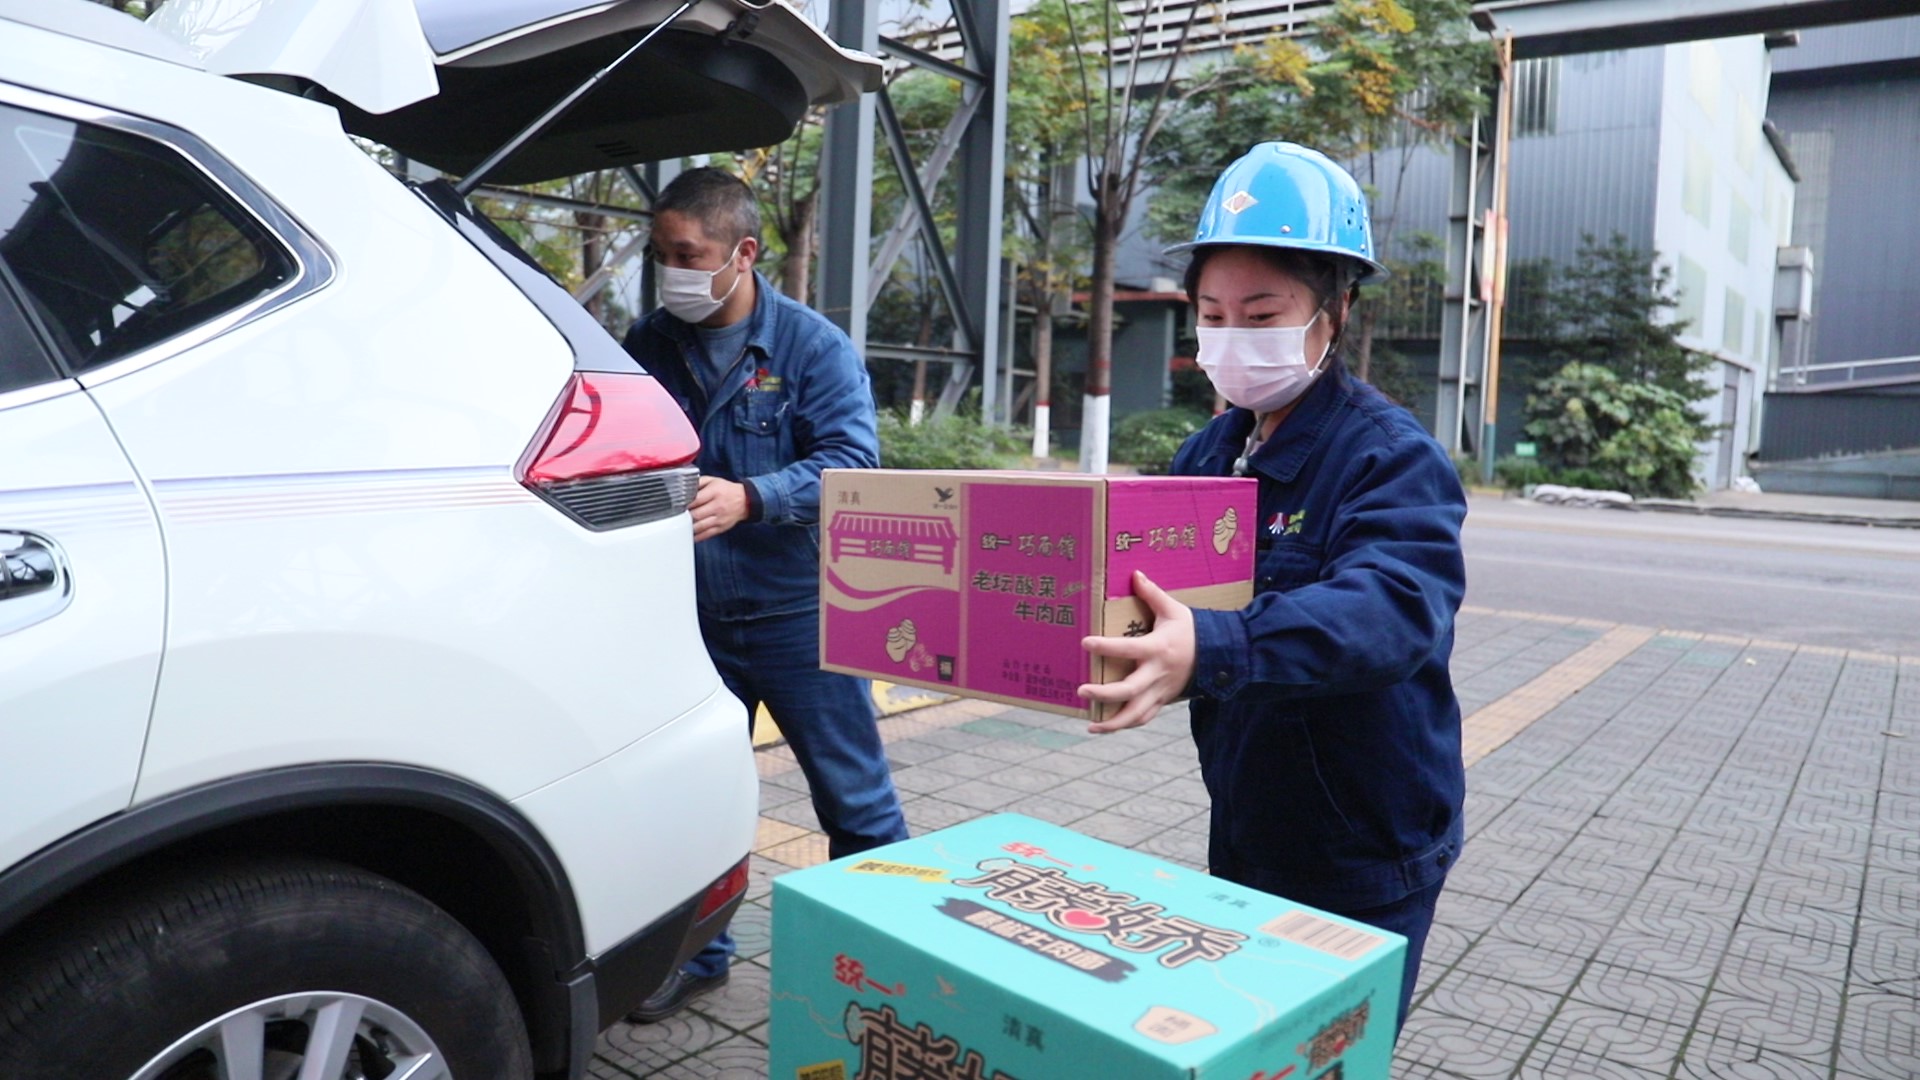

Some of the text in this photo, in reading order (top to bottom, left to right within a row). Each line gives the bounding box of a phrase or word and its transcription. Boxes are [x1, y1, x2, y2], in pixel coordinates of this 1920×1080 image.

[980, 533, 1011, 550] 统一
[1115, 531, 1143, 551] 统一
[972, 570, 1056, 599] 老坛酸菜
[1015, 600, 1076, 626] 牛肉面
[834, 953, 894, 994] 统一
[1003, 1013, 1045, 1053] 清真
